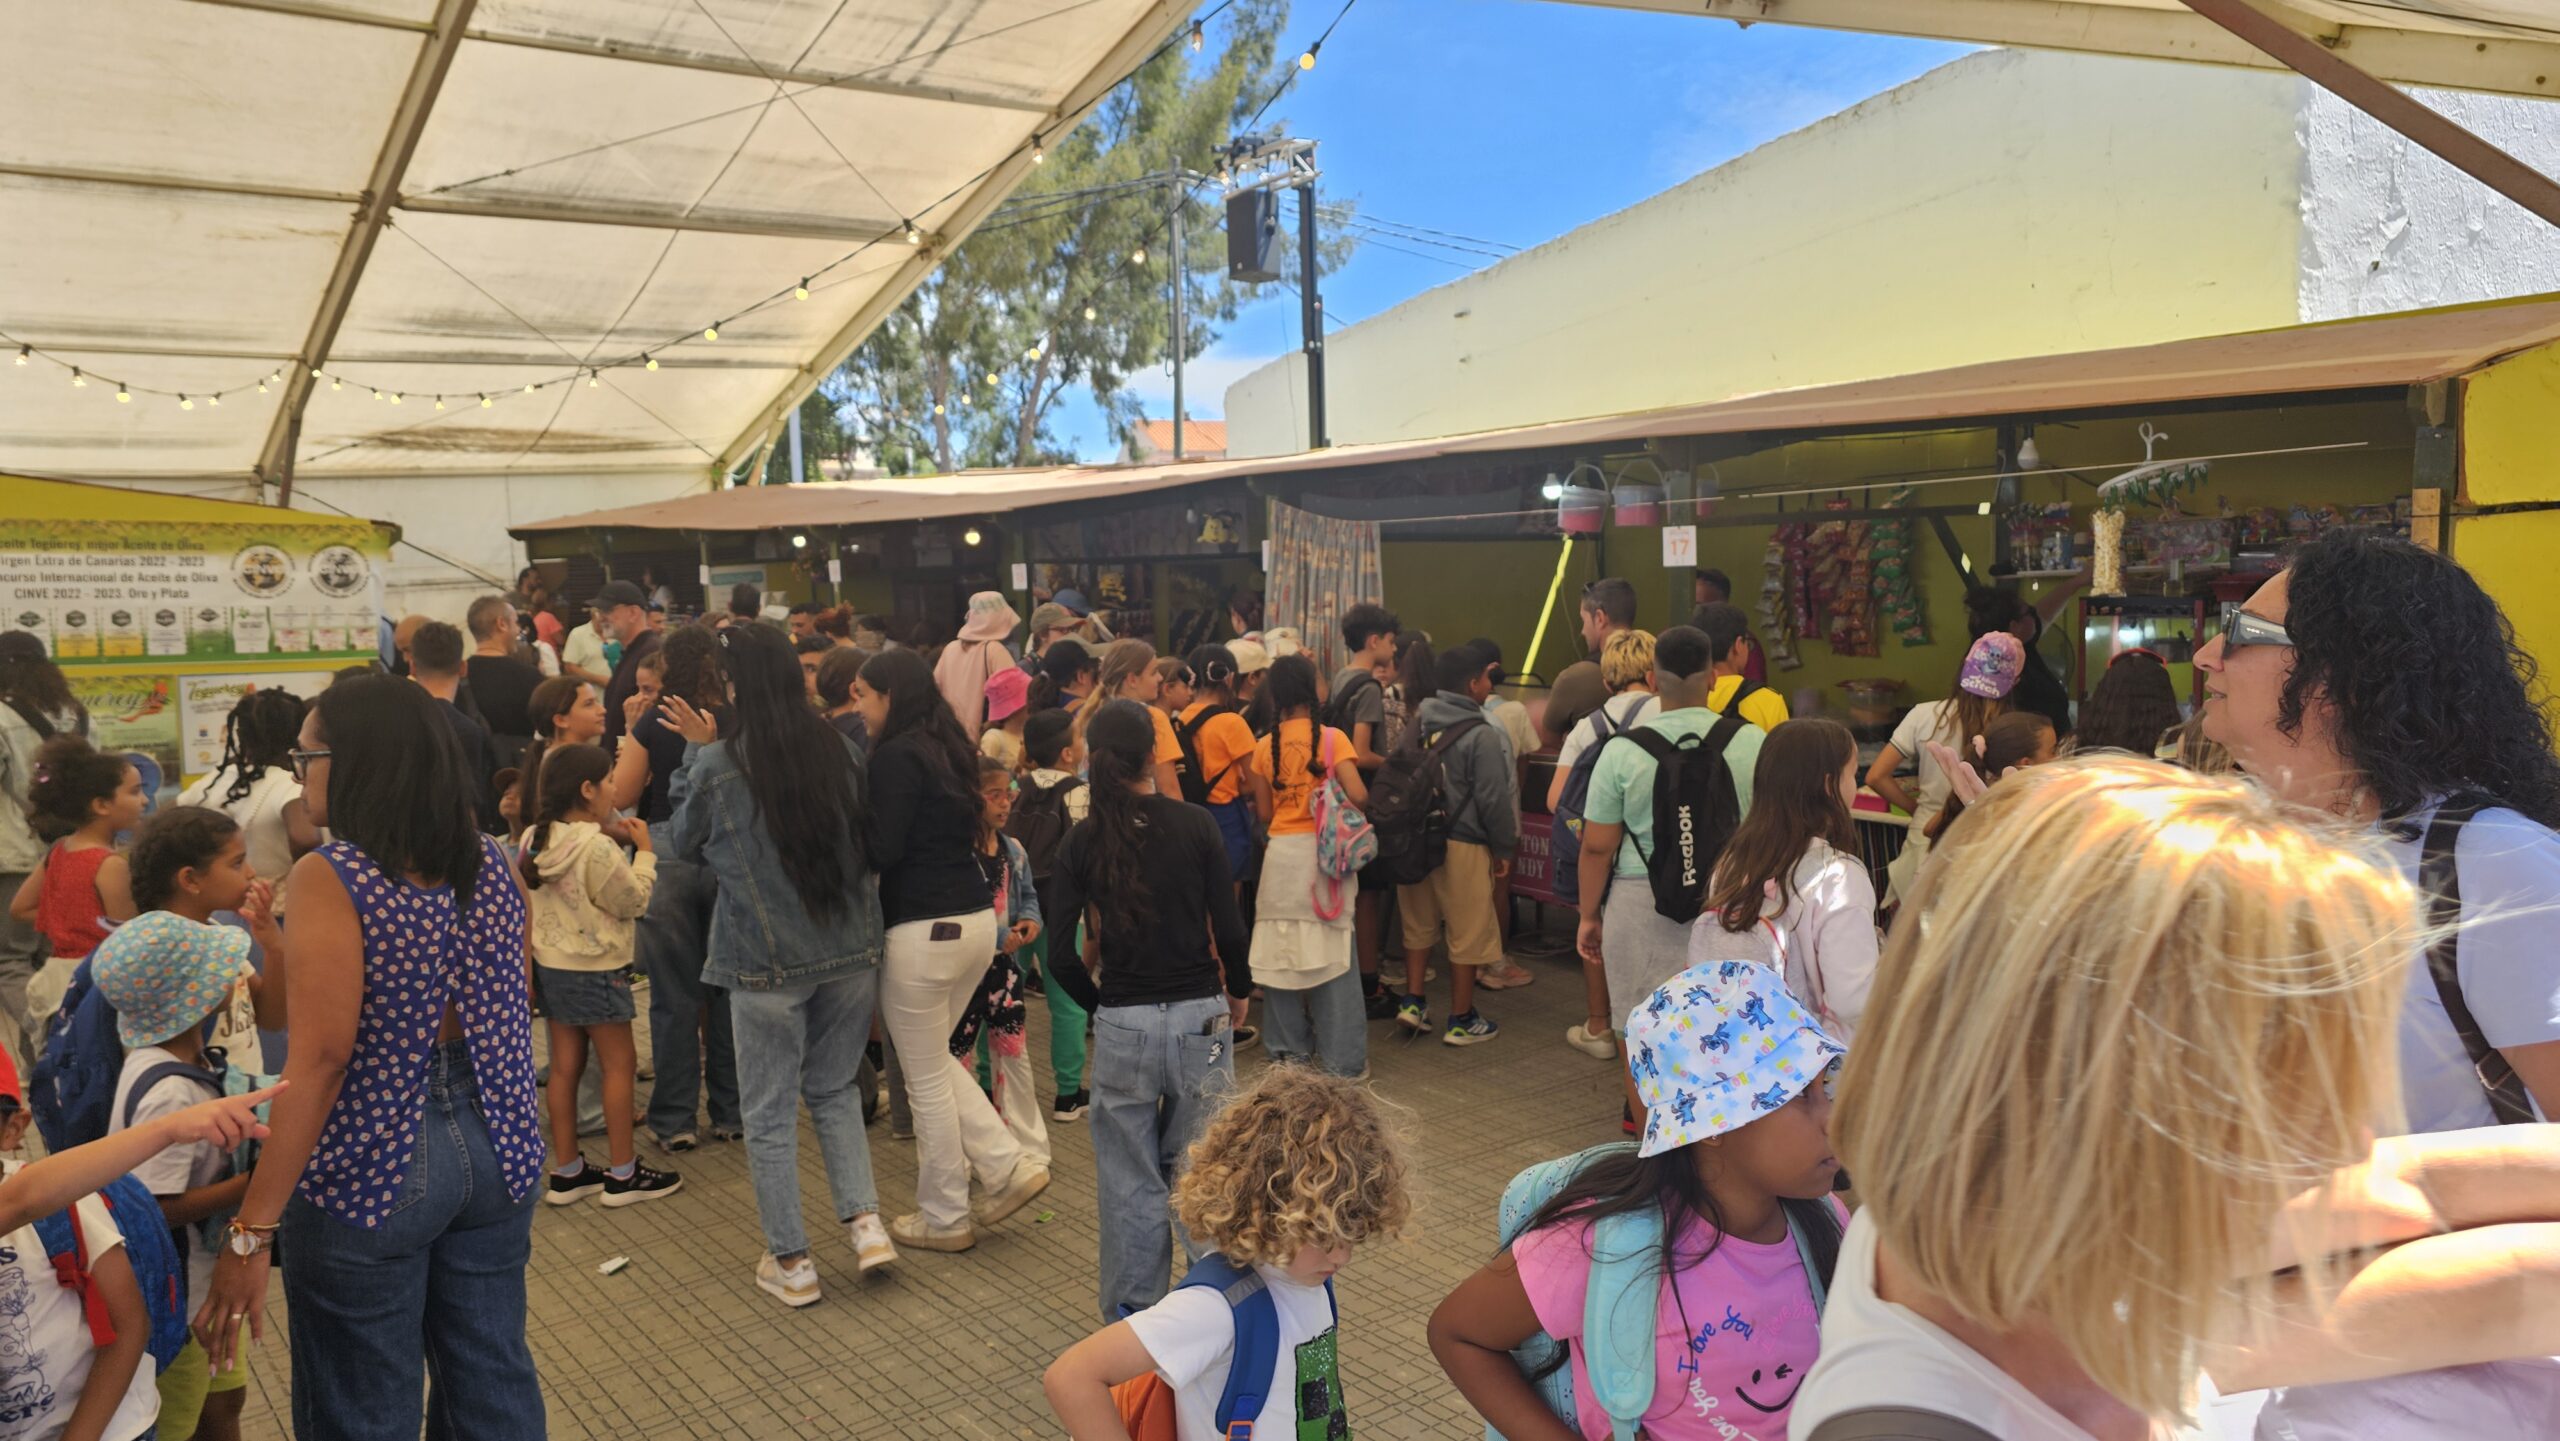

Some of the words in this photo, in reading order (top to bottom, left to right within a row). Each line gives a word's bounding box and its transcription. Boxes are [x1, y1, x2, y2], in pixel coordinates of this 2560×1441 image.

[161, 539, 174, 551] de
[177, 537, 205, 551] Oliva
[1670, 538, 1689, 556] 17
[35, 555, 64, 566] Extra
[69, 555, 81, 566] de
[86, 555, 136, 566] Canarias
[140, 555, 166, 567] 2022
[40, 571, 117, 582] Internacional
[121, 572, 134, 582] de
[138, 572, 170, 582] Aceite
[175, 572, 188, 582] de
[191, 572, 218, 582] Oliva
[14, 588, 49, 599] CINVE
[53, 588, 81, 599] 2022
[128, 588, 149, 599] Oro
[151, 590, 157, 600] y
[161, 588, 189, 599] Plata
[1678, 804, 1697, 887] Reebok
